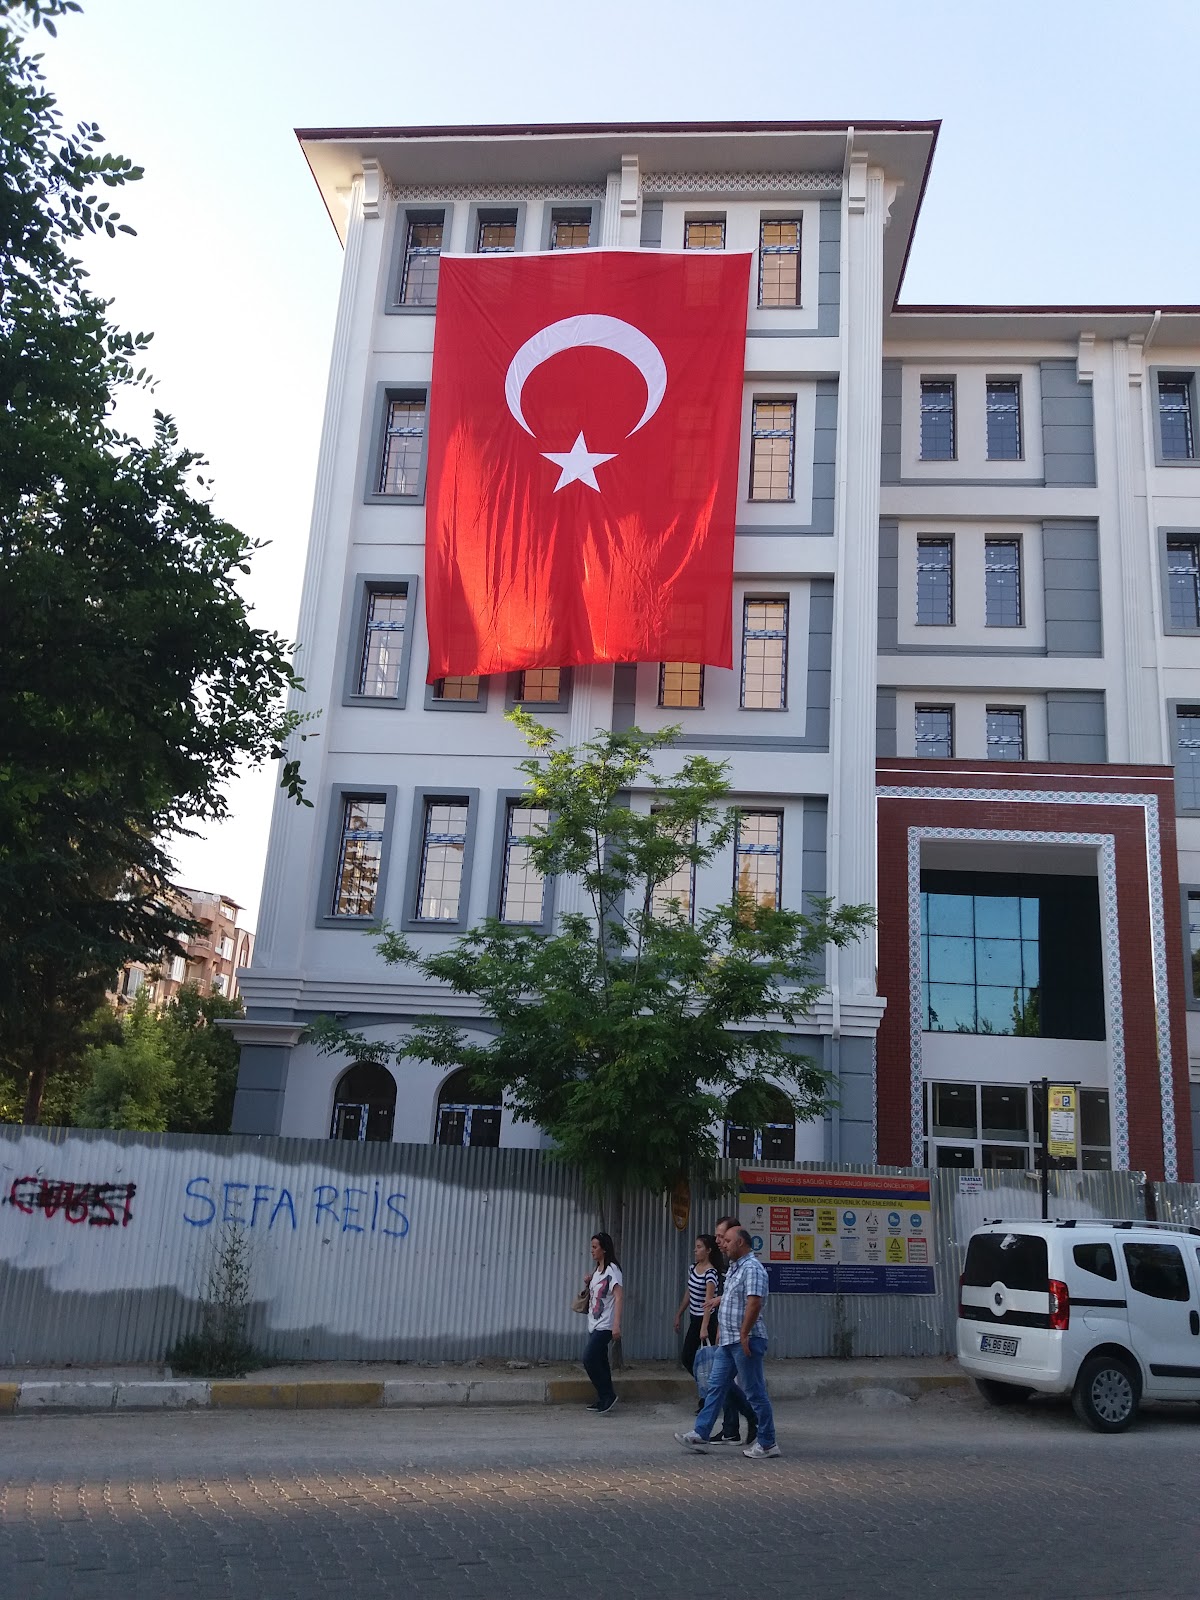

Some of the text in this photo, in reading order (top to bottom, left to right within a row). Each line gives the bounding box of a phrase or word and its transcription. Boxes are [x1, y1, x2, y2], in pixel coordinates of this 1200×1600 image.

[183, 1177, 298, 1231] SEFA
[778, 1196, 817, 1204] BAŞLAMADAN
[992, 1339, 1002, 1350] BG
